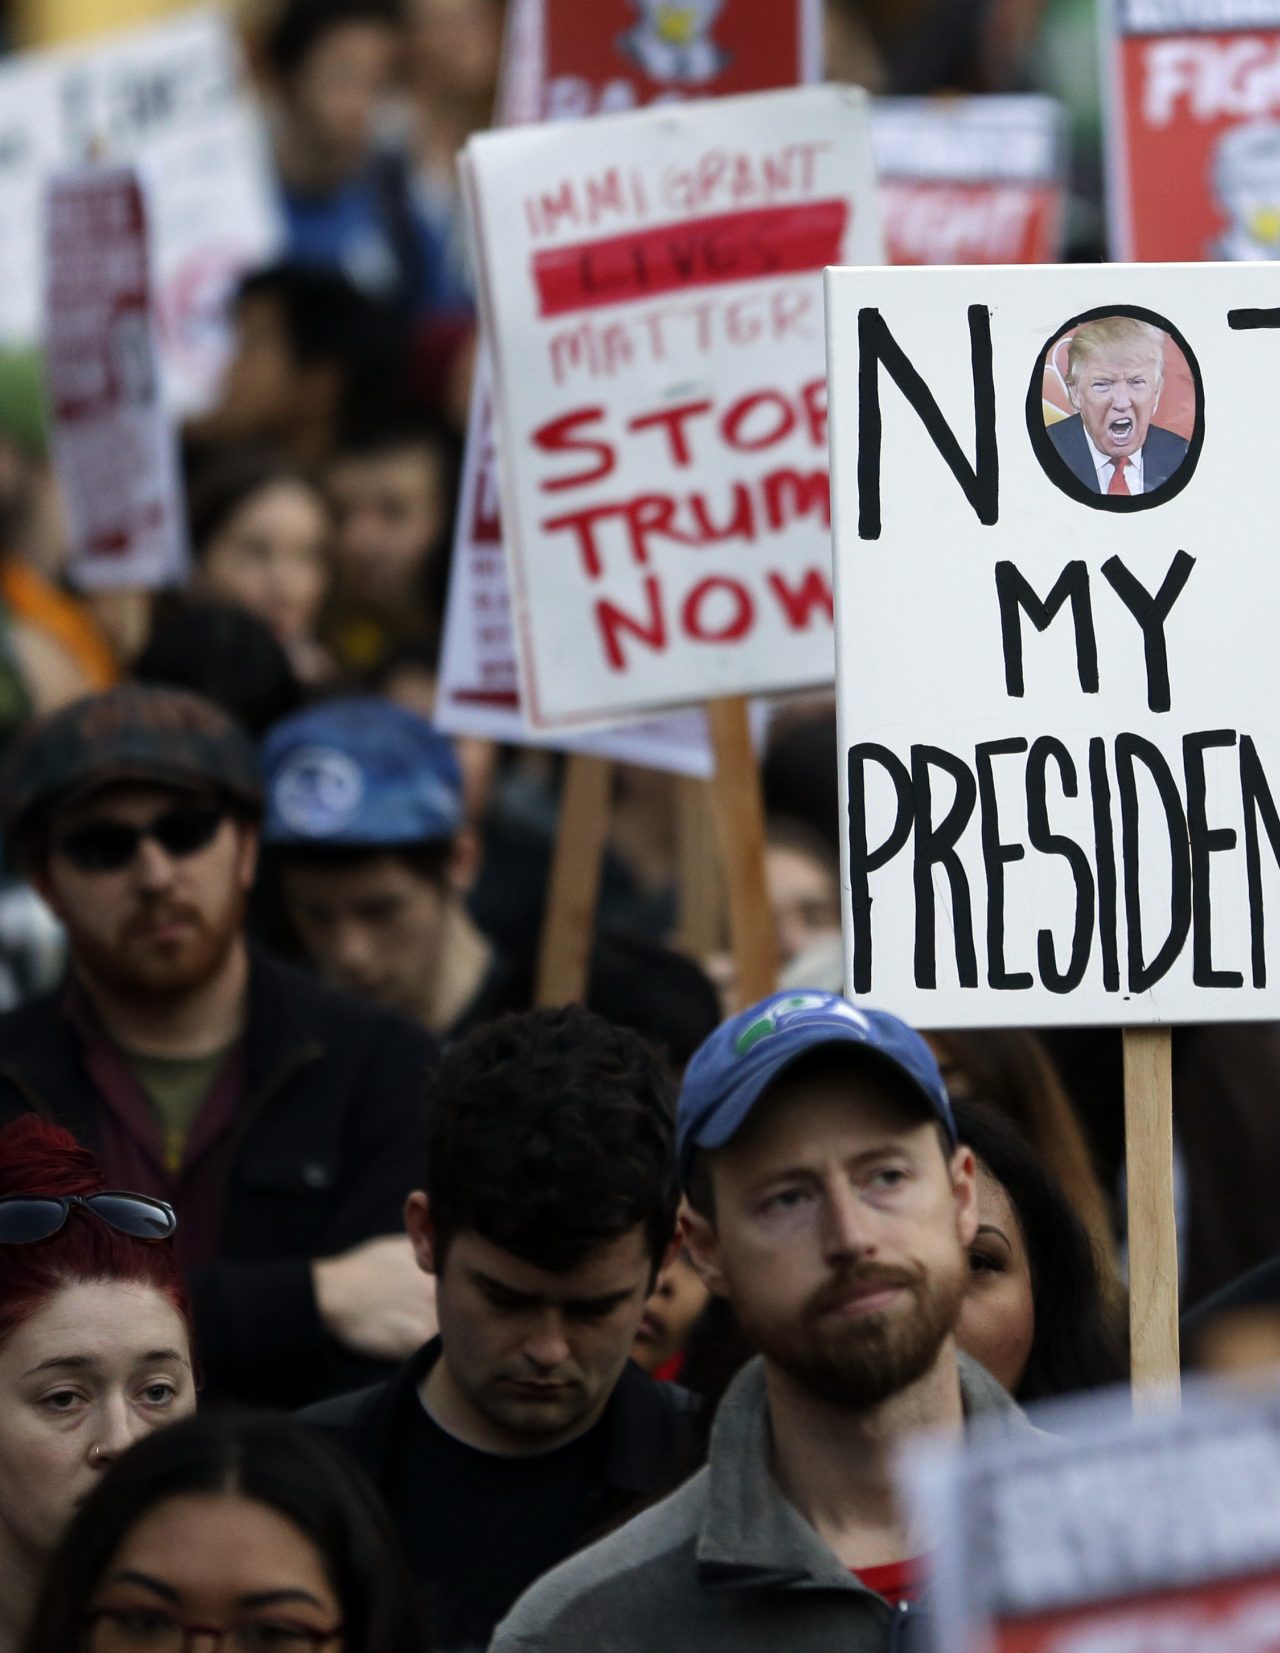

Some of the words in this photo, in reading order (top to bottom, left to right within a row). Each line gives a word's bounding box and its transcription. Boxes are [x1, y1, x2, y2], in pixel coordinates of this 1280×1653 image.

[523, 140, 832, 238] IMMIGRANT
[576, 222, 782, 294] LIVES
[548, 285, 822, 386] MATTER
[540, 465, 833, 585] TRUM
[592, 565, 834, 674] NOW
[995, 549, 1197, 713] MY
